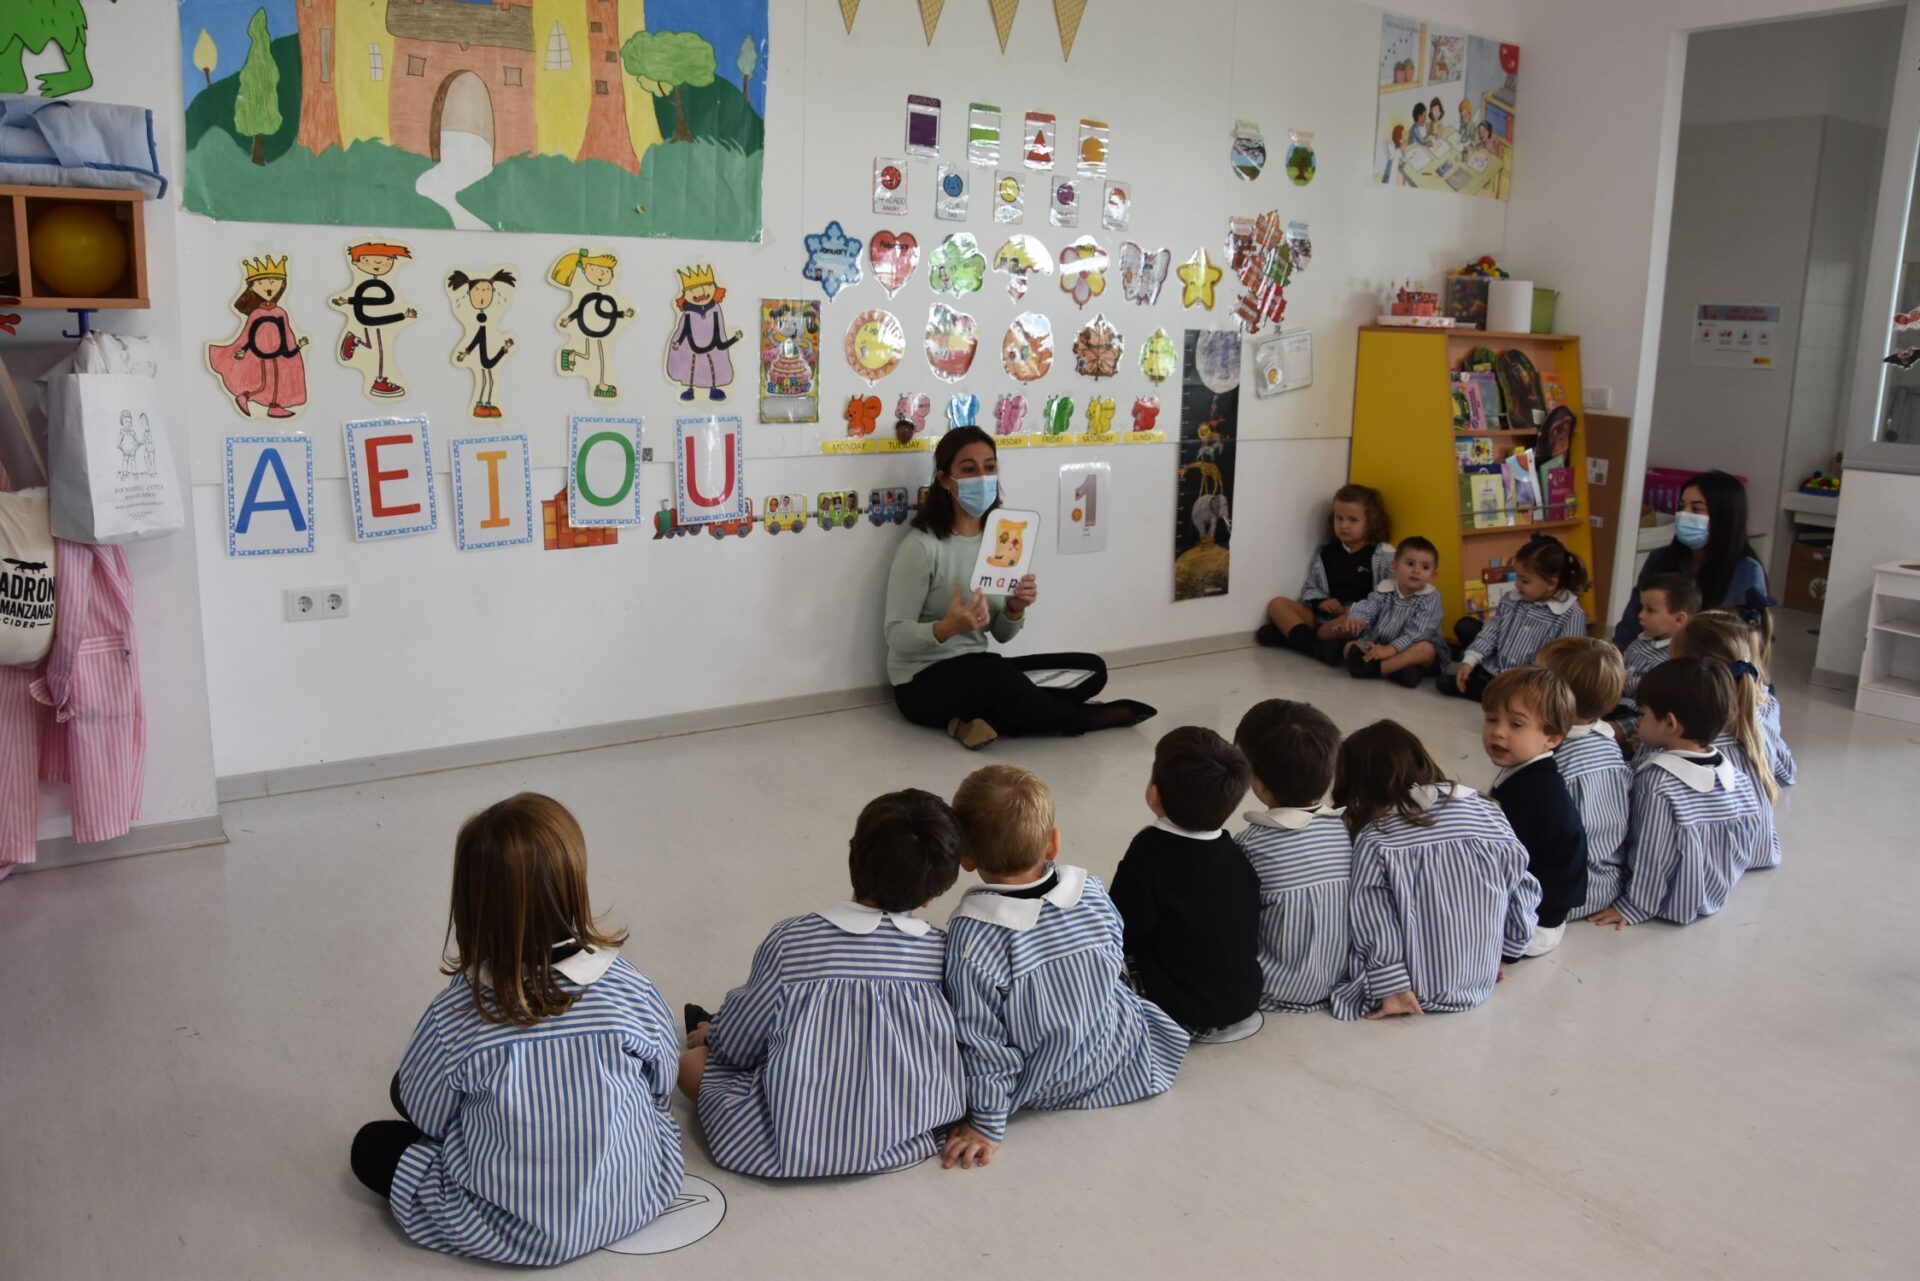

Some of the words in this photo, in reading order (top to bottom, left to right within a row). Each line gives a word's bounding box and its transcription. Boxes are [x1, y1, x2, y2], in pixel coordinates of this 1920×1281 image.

[820, 245, 848, 257] January
[243, 316, 299, 359] a
[348, 278, 405, 326] e
[466, 312, 508, 369] i
[568, 292, 625, 338] o
[832, 442, 866, 451] MONDAY
[1042, 435, 1064, 443] FRIDAY
[1083, 434, 1113, 442] SATURDAY
[235, 447, 307, 534] A
[364, 434, 421, 518] E
[476, 451, 511, 529] I
[576, 431, 635, 507] O
[685, 433, 735, 507] U
[1075, 474, 1097, 527] 1
[0, 599, 54, 620] MANZANAS
[2, 617, 36, 629] CIDER
